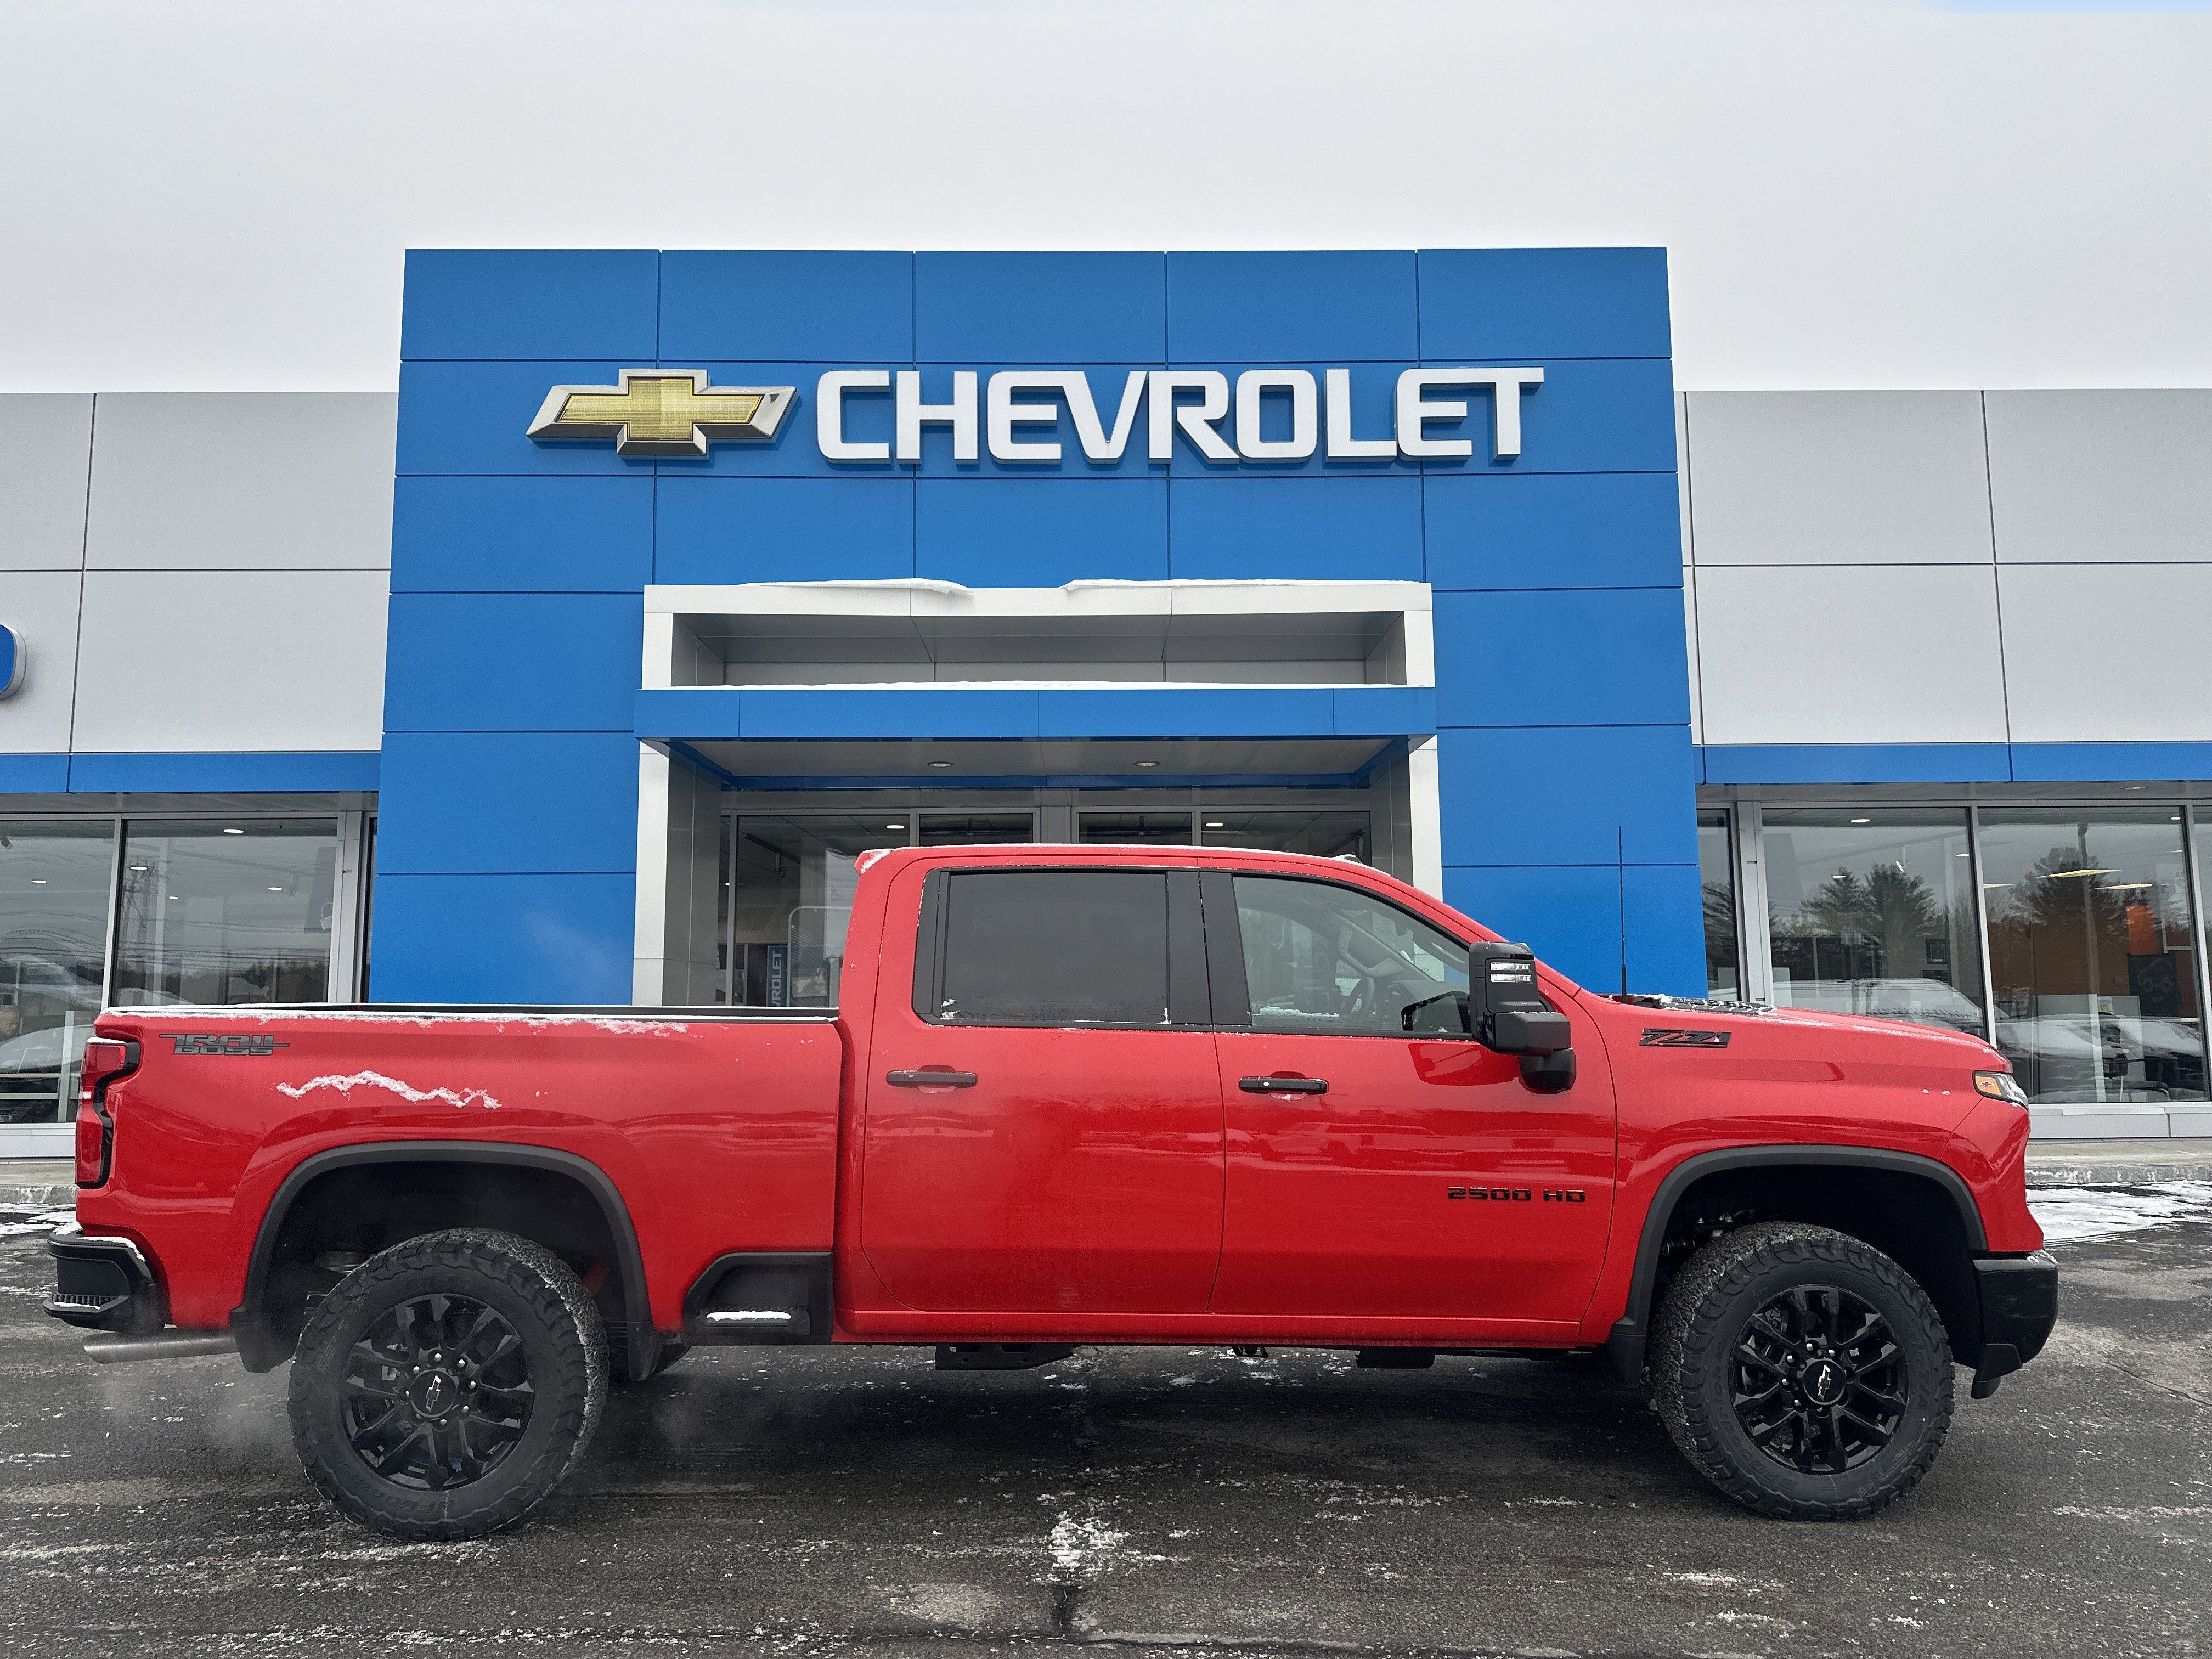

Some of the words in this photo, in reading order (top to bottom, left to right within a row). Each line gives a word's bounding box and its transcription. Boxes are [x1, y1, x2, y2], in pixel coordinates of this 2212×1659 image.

[817, 366, 1545, 465] CHEVROLET
[771, 950, 782, 1007] VROLET
[159, 1034, 290, 1047] TRAIL
[1639, 1028, 1733, 1048] Z71
[173, 1045, 274, 1056] BOSS
[1448, 1186, 1532, 1201] 2500
[1542, 1188, 1587, 1202] HD
